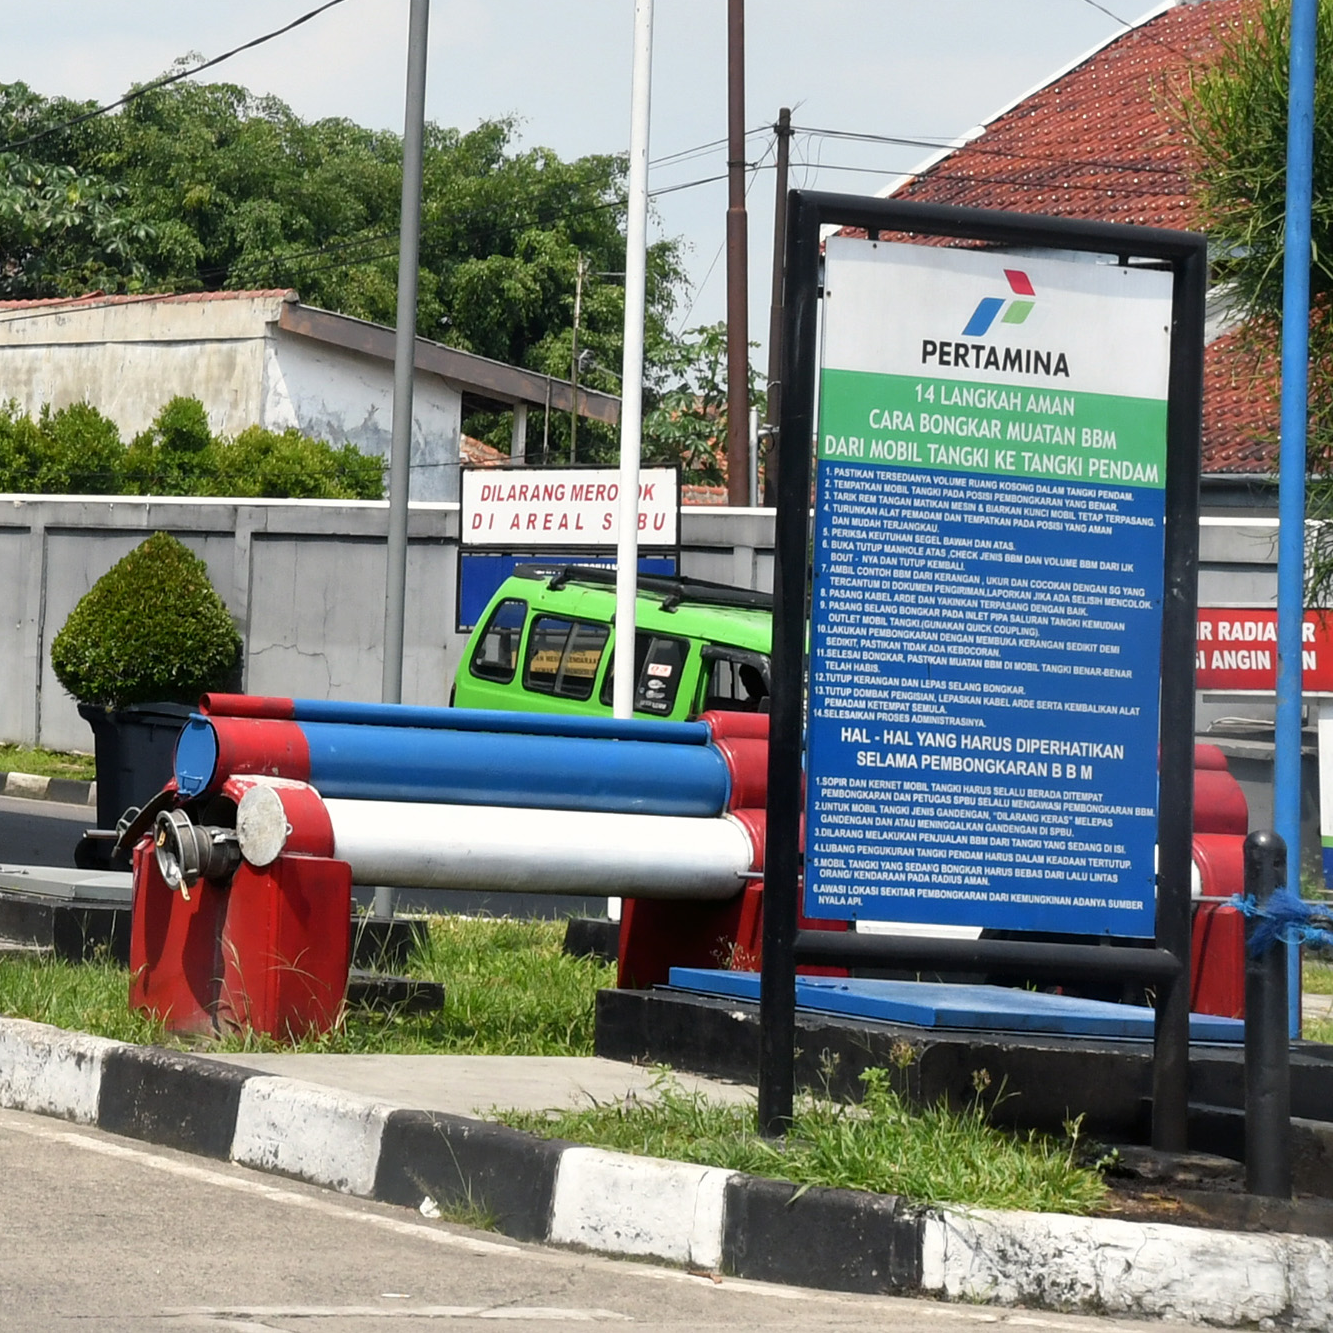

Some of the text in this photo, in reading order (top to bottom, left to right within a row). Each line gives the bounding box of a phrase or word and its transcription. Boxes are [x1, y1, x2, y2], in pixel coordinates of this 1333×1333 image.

[921, 340, 1070, 377] PERTAMINA
[914, 383, 1074, 416] 14 LANGKAH AMAN
[869, 408, 1117, 449] CARA BONGKAR MUATAN BBM
[825, 434, 1158, 483] DARI MOBIL TANGKI KE TANGKI PENDAM
[480, 484, 656, 501] DILARANG MEROK
[834, 467, 874, 479] PASTIKAN
[876, 470, 931, 484] TERSEDIANYA
[933, 475, 966, 487] VOLUME
[968, 478, 997, 489] RUANG
[999, 481, 1034, 493] KOSONG
[1036, 484, 1064, 495] DALAM
[1066, 487, 1096, 498] TANGKI
[472, 513, 666, 531] DI AREAL SBU
[831, 515, 849, 525] DAN
[851, 517, 881, 528] MUDAH
[831, 527, 866, 539] PERIKSA
[868, 530, 912, 542] KEUTUHAN
[914, 534, 941, 545] SEGEL
[943, 536, 972, 547] BAWAH
[974, 538, 991, 549] DAN
[1218, 621, 1316, 642] RADIAR
[825, 660, 851, 671] TELAH
[1211, 650, 1271, 669] ANGIN
[814, 672, 852, 683] 12.TUTUP
[853, 675, 899, 687] KERANGAN
[901, 678, 918, 688] DAN
[920, 679, 946, 690] LEPAS
[948, 681, 981, 692] SELANG
[824, 697, 865, 708] PEMADAM
[867, 700, 909, 711] KETEMPAT
[841, 727, 1123, 759] HAL HAL YANG HARUS DIPERHATIKAN
[856, 750, 1092, 780] SELAMA PEMBONGKARAN B B M
[815, 776, 1102, 802] 1.SOPIR DAN KERNET MOBIL TANGKI HARUS SELALU BERADA DITEMPAT
[820, 813, 873, 825] GANDENGAN
[875, 816, 892, 826] DAN
[894, 817, 915, 827] ATAU
[917, 818, 983, 831] MENINGGALKAN
[985, 823, 1037, 835] GANDENGAN
[1039, 826, 1047, 835] DI
[819, 867, 852, 878] ORANG/
[853, 869, 905, 881] KENDARAAN
[907, 872, 929, 882] PADA
[931, 873, 962, 884] RADIUS
